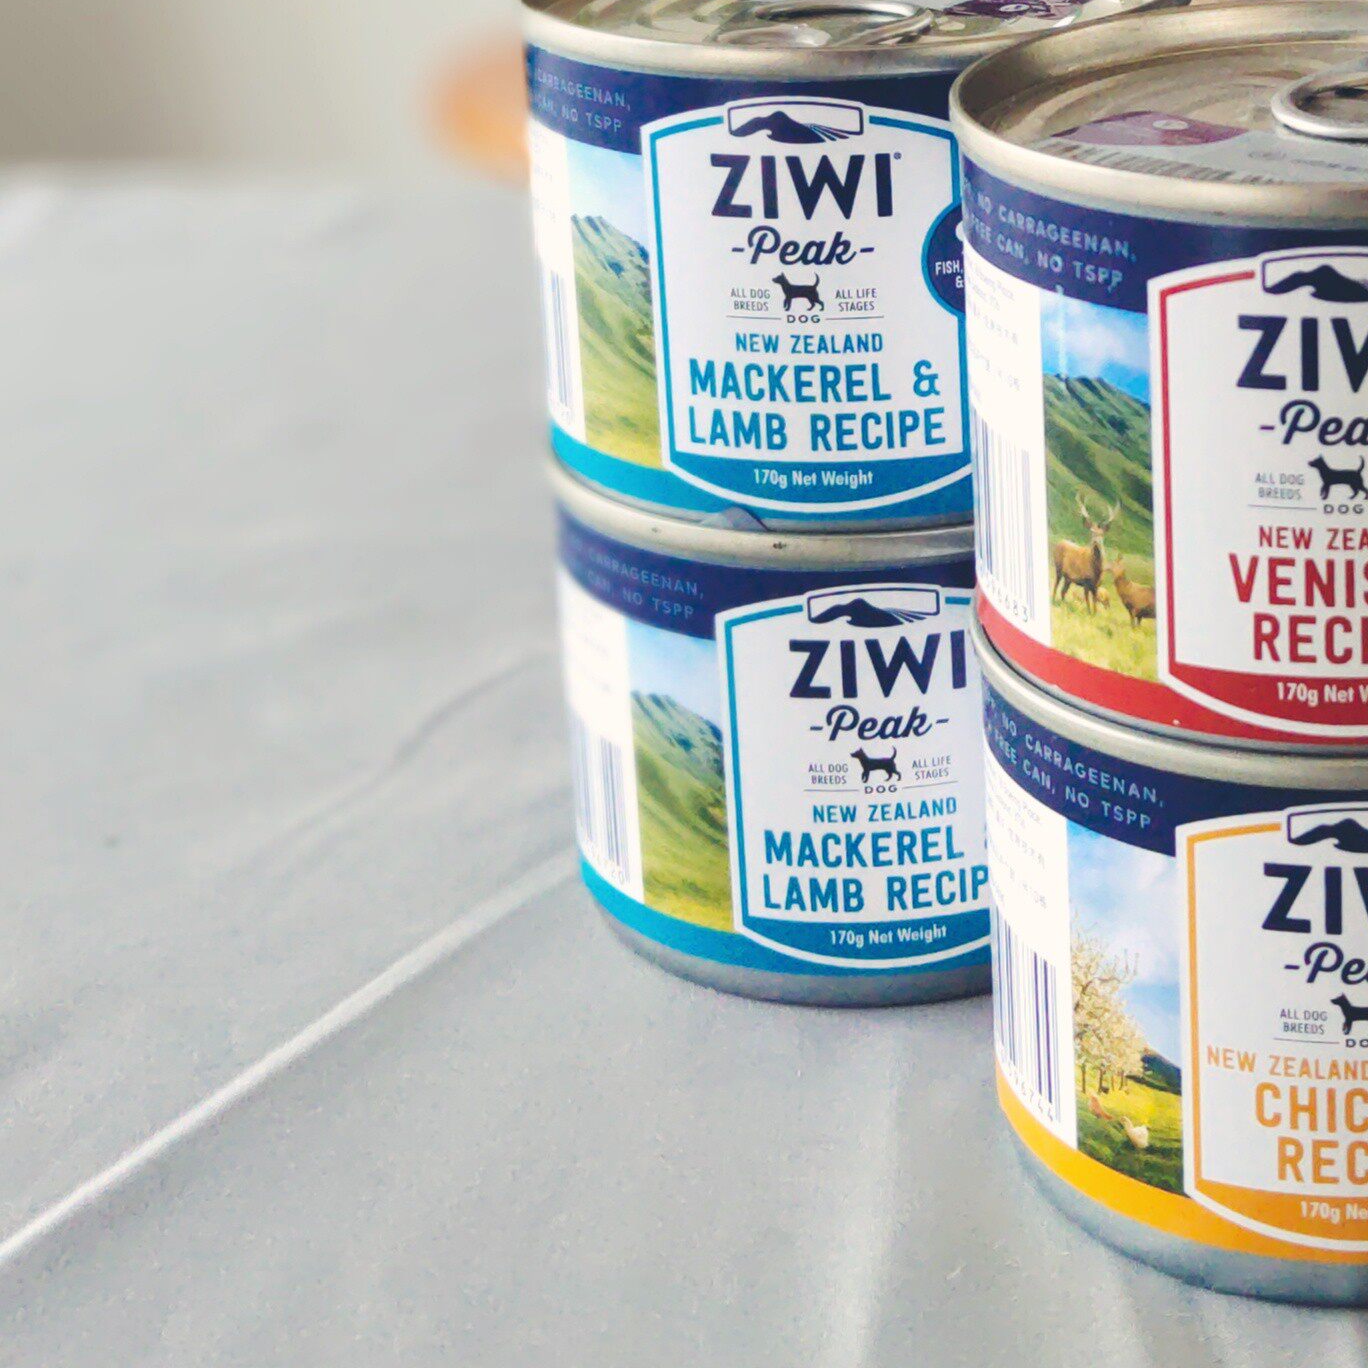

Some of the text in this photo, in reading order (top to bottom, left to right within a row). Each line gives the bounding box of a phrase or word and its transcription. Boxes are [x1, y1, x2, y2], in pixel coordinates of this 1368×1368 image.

[561, 104, 578, 123] NO
[586, 112, 622, 132] TSPP
[710, 153, 893, 221] ZIWI
[998, 204, 1137, 263] CARRAGEENAN,
[955, 276, 964, 288] &
[1037, 250, 1064, 274] NO
[1072, 260, 1123, 292] TSPP
[731, 288, 771, 300] ALL DOG
[835, 288, 877, 300] ALL LIFE
[733, 301, 769, 312] BREEDS
[838, 301, 875, 312] STAGES
[786, 314, 821, 324] DOG
[735, 333, 883, 354] NEW ZEALAND
[689, 358, 892, 403] MACKEREL
[913, 359, 941, 397] &
[688, 406, 946, 451] LAMB RECIPE
[754, 468, 873, 489] 170g Net Weight
[1255, 472, 1305, 486] ALL DOG
[1258, 488, 1301, 500] BREEDS
[1323, 504, 1364, 515] DOG
[1258, 525, 1312, 550] NEW
[622, 588, 643, 606] NO
[652, 597, 694, 619] TSPP
[789, 629, 967, 699] ZIWI
[1276, 682, 1319, 706] 170g
[1324, 684, 1355, 703] Net
[808, 762, 849, 774] ALL DOG
[912, 755, 952, 769] ALL LIFE
[1025, 733, 1165, 808] CARRAGEENAN,
[811, 774, 847, 785] BREEDS
[915, 768, 949, 780] STAGES
[864, 785, 898, 795] DOG
[1023, 757, 1056, 795] CAN,
[1065, 785, 1090, 809] NO
[1101, 800, 1151, 829] TSPP
[812, 796, 957, 823] NEW ZEALAND
[763, 824, 965, 868] MACKEREL
[763, 873, 865, 913] LAMB
[886, 864, 989, 912] RECIP
[830, 924, 947, 948] 170g Net Weight
[1280, 1008, 1328, 1021] ALL DOG
[1283, 1022, 1325, 1034] BREEDS
[1206, 1044, 1256, 1073] NEW
[1300, 1200, 1341, 1224] 170g
